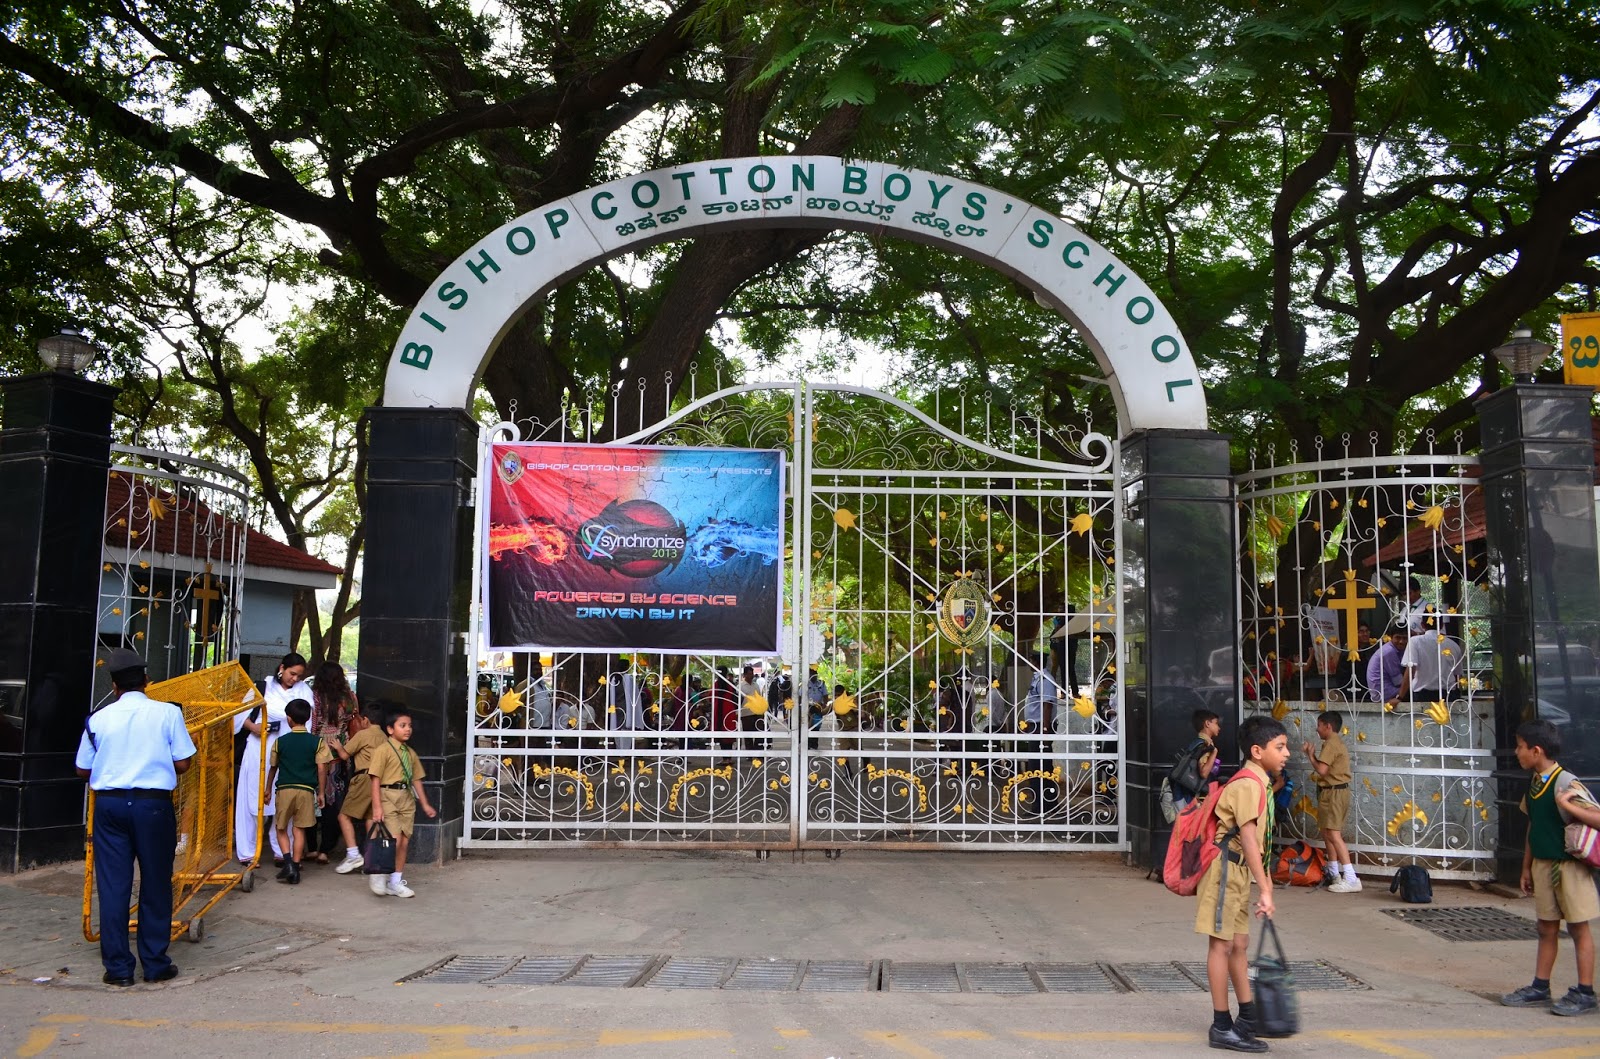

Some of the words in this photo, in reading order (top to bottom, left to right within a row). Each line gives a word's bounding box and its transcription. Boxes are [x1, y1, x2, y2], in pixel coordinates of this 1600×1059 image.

[615, 204, 687, 237] ಬಿಷಪ್
[702, 195, 793, 216] ಕಾಟನ್
[806, 197, 896, 221] ಬಾಯ್ಸ್
[911, 211, 988, 238] ಸ್ಕೂಲ್
[400, 208, 570, 371] BISHOP
[591, 163, 815, 221] COTTON
[1027, 219, 1193, 402] SCHOOL
[526, 462, 570, 471] BISHOP
[572, 464, 620, 472] COTTON
[659, 466, 707, 474] SCHOOL
[709, 467, 773, 476] PRESENTS
[600, 533, 685, 551] synchronize
[651, 548, 678, 558] 2013
[534, 590, 626, 603] POWERED
[629, 592, 657, 604] BY
[659, 593, 737, 606] SCIENCE
[575, 606, 644, 619] DRIVEN
[648, 608, 675, 620] BY
[678, 609, 695, 620] IT
